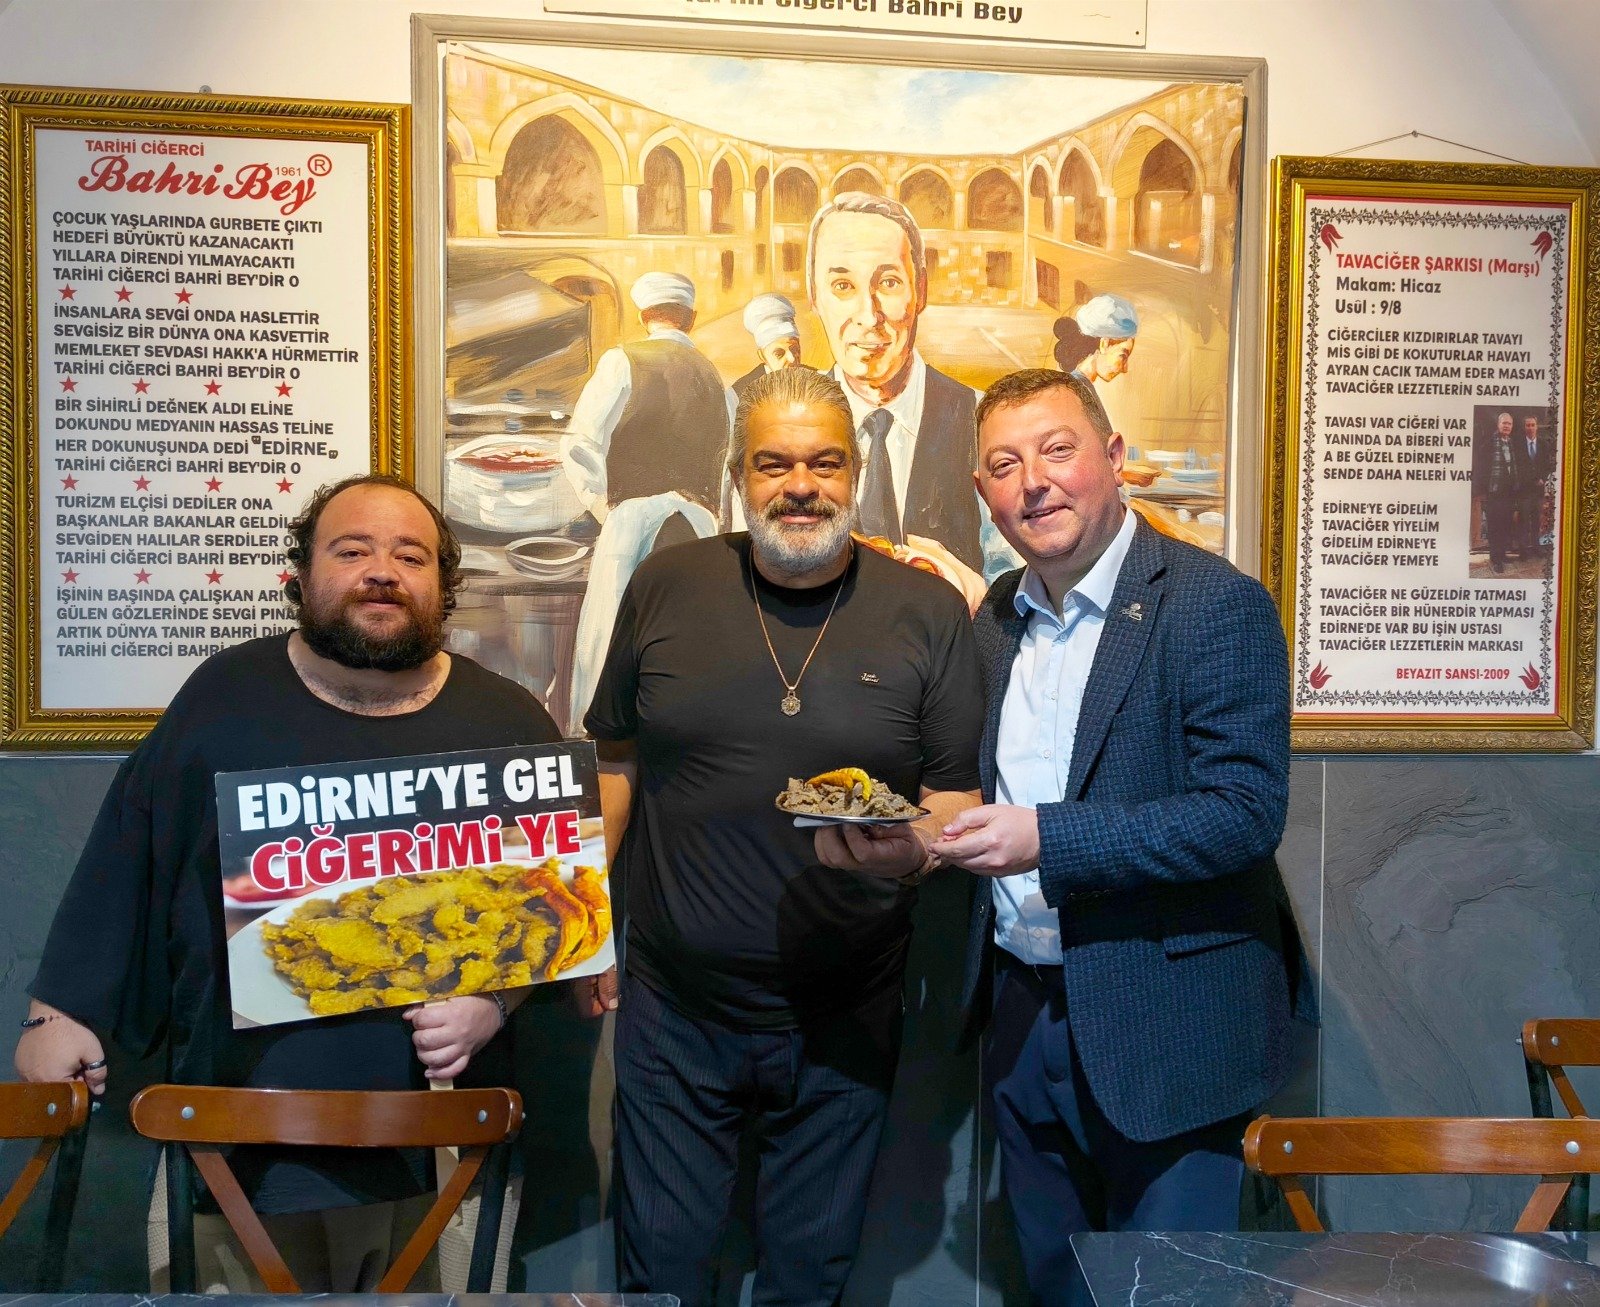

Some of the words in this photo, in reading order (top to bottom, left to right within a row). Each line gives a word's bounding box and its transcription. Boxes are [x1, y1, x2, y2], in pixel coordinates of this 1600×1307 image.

[889, 0, 962, 18] Bahri
[974, 2, 1023, 24] Bey
[85, 138, 136, 153] TARİHİ
[141, 140, 204, 156] CİĞERCİ
[275, 166, 302, 177] 1961
[78, 154, 225, 195] Bahri
[222, 162, 317, 215] Bey
[52, 211, 107, 227] ÇOCUK
[110, 213, 206, 230] YAŞLARINDA
[209, 217, 280, 232] GURBETE
[284, 220, 322, 236] ÇIKTI
[53, 229, 108, 244] HEDEFİ
[113, 229, 185, 247] BÜYÜKTÜ
[189, 235, 293, 250] KAZANACAKTI
[52, 249, 116, 263] YILLARA
[121, 248, 183, 265] DİRENDİ
[187, 253, 294, 269] YILMAYACAKTI
[1336, 251, 1420, 270] TAVACİĞER
[1425, 256, 1482, 275] ŞARKISI
[53, 265, 103, 281] TARİHİ
[108, 266, 170, 283] CİĞERCİ
[175, 270, 222, 285] BAHRİ
[226, 272, 285, 287] BEY'DİR
[289, 275, 299, 287] O
[1336, 276, 1395, 292] Makam:
[1401, 278, 1441, 293] Hicaz
[54, 305, 142, 320] İNSANLARA
[145, 306, 189, 321] SEVGİ
[194, 309, 236, 323] ONDA
[240, 310, 319, 325] HASLETTİR
[1380, 300, 1401, 316] 9/8
[53, 322, 124, 338] SEVGİSİZ
[128, 323, 154, 339] BİR
[159, 324, 210, 340] DÜNYA
[214, 328, 245, 341] ONA
[250, 328, 329, 343] KASVETTİR
[1328, 326, 1399, 342] CİĞERCİLER
[1403, 331, 1479, 344] KIZDIRIRLAR
[1482, 333, 1522, 345] TAVAYI
[55, 343, 141, 357] MEMLEKET
[144, 345, 208, 359] SEVDASI
[213, 347, 268, 360] HAKK'A
[272, 346, 359, 363] HÜRMETTİR
[1327, 344, 1351, 358] MİS
[1354, 345, 1380, 359] GİBİ
[1384, 348, 1399, 360] DE
[1403, 348, 1483, 361] KOKUTURLAR
[1487, 350, 1530, 362] HAVAYI
[54, 359, 104, 375] TARİHİ
[109, 360, 171, 376] CİĞERCİ
[175, 362, 222, 377] BAHRİ
[227, 364, 285, 379] BEY'DİR
[290, 367, 300, 380] O
[1326, 364, 1369, 376] AYRAN
[1372, 365, 1411, 377] CACIK
[1414, 366, 1461, 378] TAMAM
[1465, 367, 1495, 379] EDER
[1499, 368, 1545, 380] MASAYI
[1326, 379, 1394, 394] TAVACİĞER
[1398, 382, 1473, 396] LEZZETLERİN
[1476, 384, 1519, 397] SARAYI
[55, 396, 82, 411] BİR
[86, 397, 141, 413] SİHİRLİ
[146, 398, 208, 414] DEĞNEK
[212, 402, 246, 415] ALDI
[251, 400, 293, 416] ELİNE
[55, 417, 131, 431] DOKUNDU
[136, 419, 215, 432] MEDYANIN
[219, 421, 279, 434] HASSAS
[282, 420, 334, 435] TELİNE
[1325, 416, 1366, 428] TAVASI
[1370, 417, 1394, 429] VAR
[1397, 415, 1439, 429] CİĞERİ
[1443, 418, 1467, 430] VAR
[55, 439, 87, 452] HER
[92, 439, 209, 456] DOKUNUŞUNDA
[213, 439, 249, 454] DEDİ
[1324, 433, 1382, 445] YANINDA
[1385, 434, 1402, 446] DA
[1406, 432, 1444, 447] BİBERİ
[1447, 435, 1471, 447] VAR
[1323, 451, 1333, 462] A
[1337, 451, 1351, 462] BE
[1354, 448, 1394, 463] GÜZEL
[1397, 449, 1454, 464] EDİRNE'M
[55, 456, 105, 471] TARİHİ
[110, 456, 171, 472] CİĞERCİ
[176, 458, 223, 473] BAHRİ
[228, 459, 286, 474] BEY'DİR
[290, 462, 301, 474] O
[1323, 468, 1363, 480] SENDE
[1367, 468, 1402, 480] DAHA
[1406, 467, 1446, 481] NELERİ
[55, 493, 115, 508] TURİZM
[120, 494, 168, 512] ELÇİSİ
[173, 494, 237, 510] DEDİLER
[241, 498, 273, 510] ONA
[1323, 500, 1382, 514] EDİRNE'YE
[1386, 501, 1438, 515] GİDELİM
[56, 514, 149, 530] BAŞKANLAR
[154, 515, 235, 528] BAKANLAR
[1322, 517, 1389, 532] TAVACİĞER
[1392, 518, 1439, 532] YİYELİM
[56, 530, 132, 545] SEVGİDEN
[137, 534, 200, 546] HALILAR
[204, 532, 279, 547] SERDİLER
[1321, 534, 1373, 548] GİDELİM
[1377, 535, 1436, 549] EDİRNE'YE
[56, 549, 106, 564] TARİHİ
[110, 549, 172, 564] CİĞERCİ
[177, 550, 224, 565] BAHRİ
[1321, 551, 1389, 566] TAVACİĞER
[1392, 555, 1438, 566] YEMEYE
[57, 586, 103, 605] İŞİNİN
[108, 589, 175, 605] BAŞINDA
[179, 589, 253, 605] ÇALIŞKAN
[1320, 585, 1387, 600] TAVACİĞER
[1391, 589, 1407, 600] NE
[1410, 586, 1471, 600] GÜZELDİR
[1474, 590, 1526, 601] TATMASI
[57, 605, 107, 620] GÜLEN
[112, 605, 209, 620] GÖZLERİNDE
[212, 605, 256, 620] SEVGİ
[1320, 602, 1387, 617] TAVACİĞER
[1391, 603, 1410, 617] BİR
[1414, 603, 1476, 617] HÜNERDİR
[1479, 606, 1534, 618] YAPMASI
[56, 626, 102, 638] ARTIK
[107, 623, 158, 638] DÜNYA
[161, 626, 206, 638] TANIR
[210, 623, 257, 639] BAHRİ
[1320, 619, 1381, 634] EDİRNE'DE
[1385, 623, 1409, 634] VAR
[1412, 623, 1428, 634] BU
[1432, 620, 1457, 637] İŞİN
[1460, 623, 1502, 635] USTASI
[56, 642, 106, 657] TARİHİ
[111, 641, 173, 657] CİĞERCİ
[1319, 637, 1386, 651] TAVACİĞER
[1390, 637, 1464, 651] LEZZETLERİN
[1468, 640, 1523, 651] MARKASI
[1396, 668, 1442, 679] BEYAZIT
[1445, 668, 1510, 680] SANSI-2009
[503, 754, 583, 803] GEL
[515, 810, 583, 860] YE
